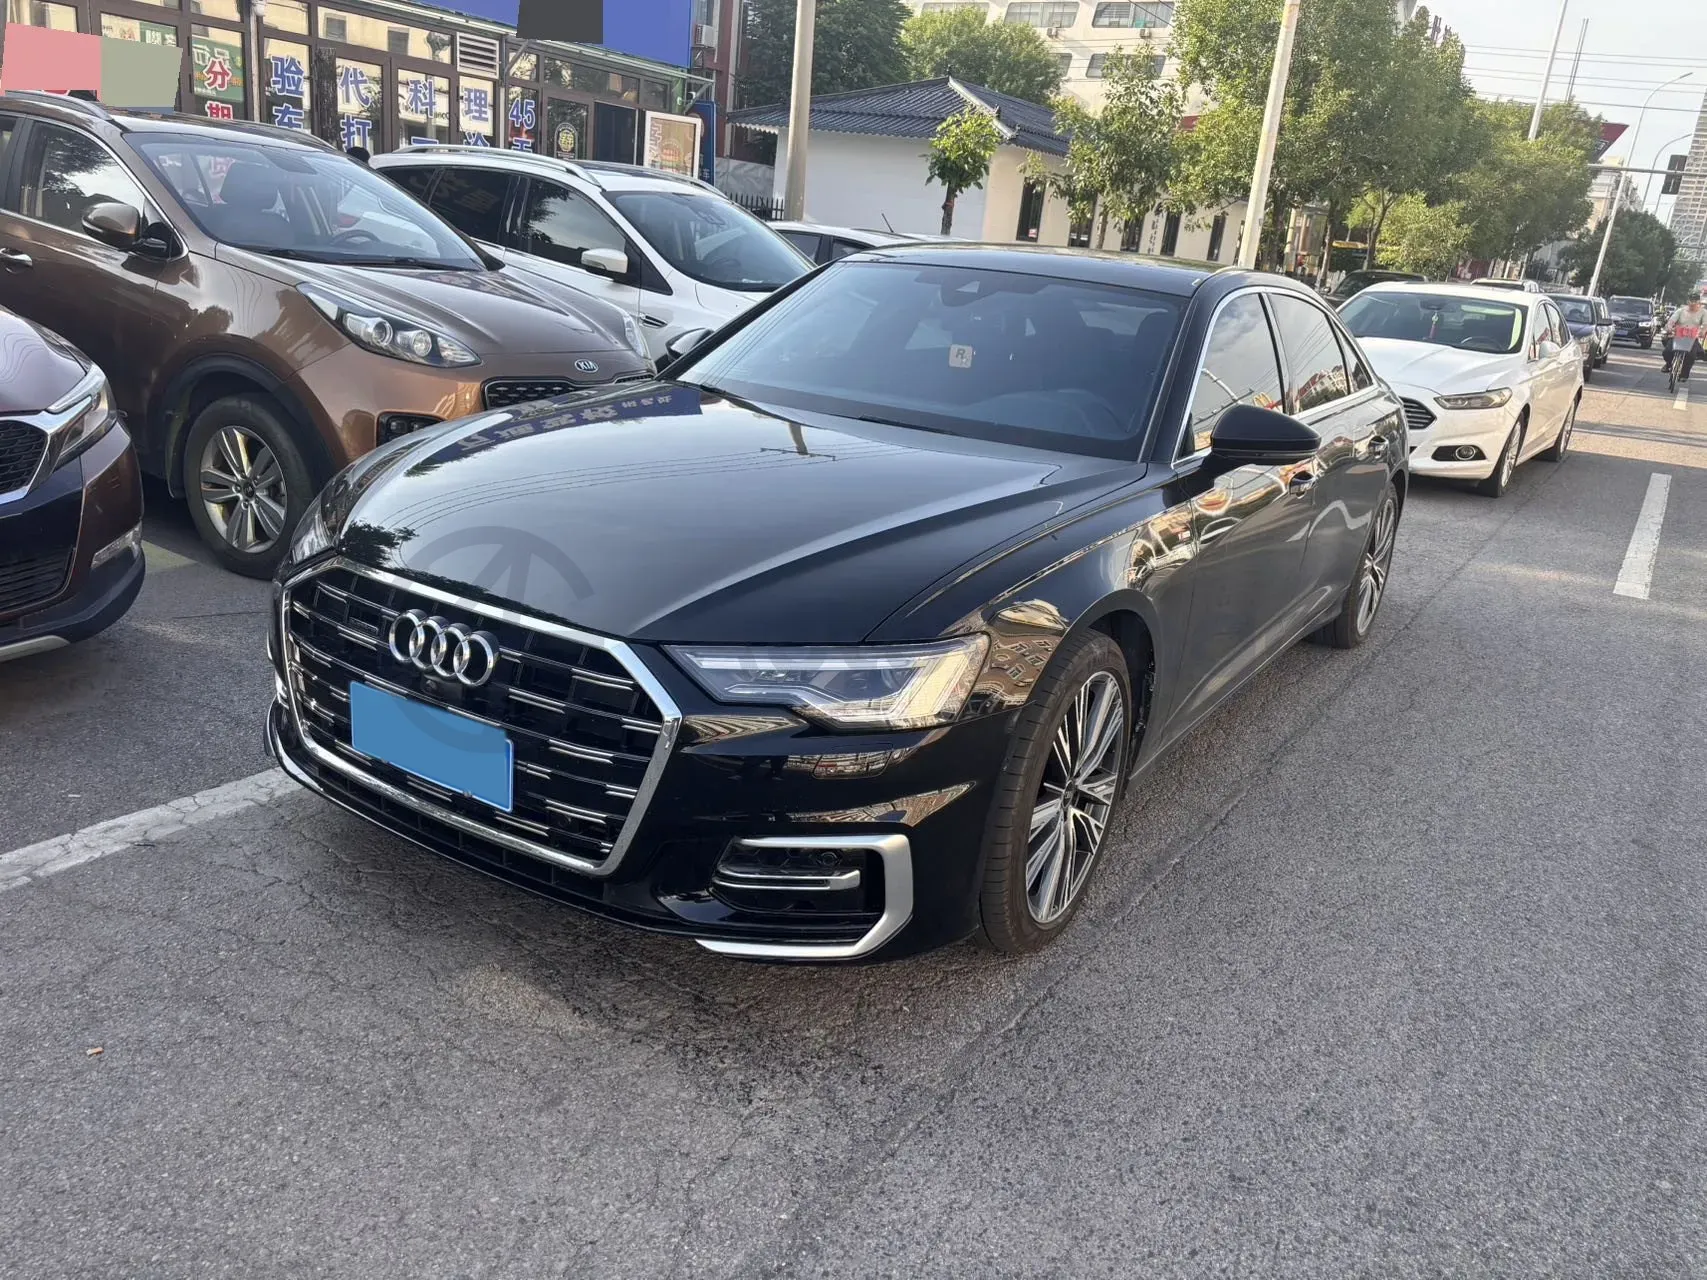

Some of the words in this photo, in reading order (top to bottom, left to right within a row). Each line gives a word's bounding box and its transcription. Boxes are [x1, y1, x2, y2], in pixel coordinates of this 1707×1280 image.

[270, 54, 305, 129] 验车
[339, 65, 373, 153] 代打
[408, 79, 439, 145] 科
[576, 360, 598, 371] KIA
